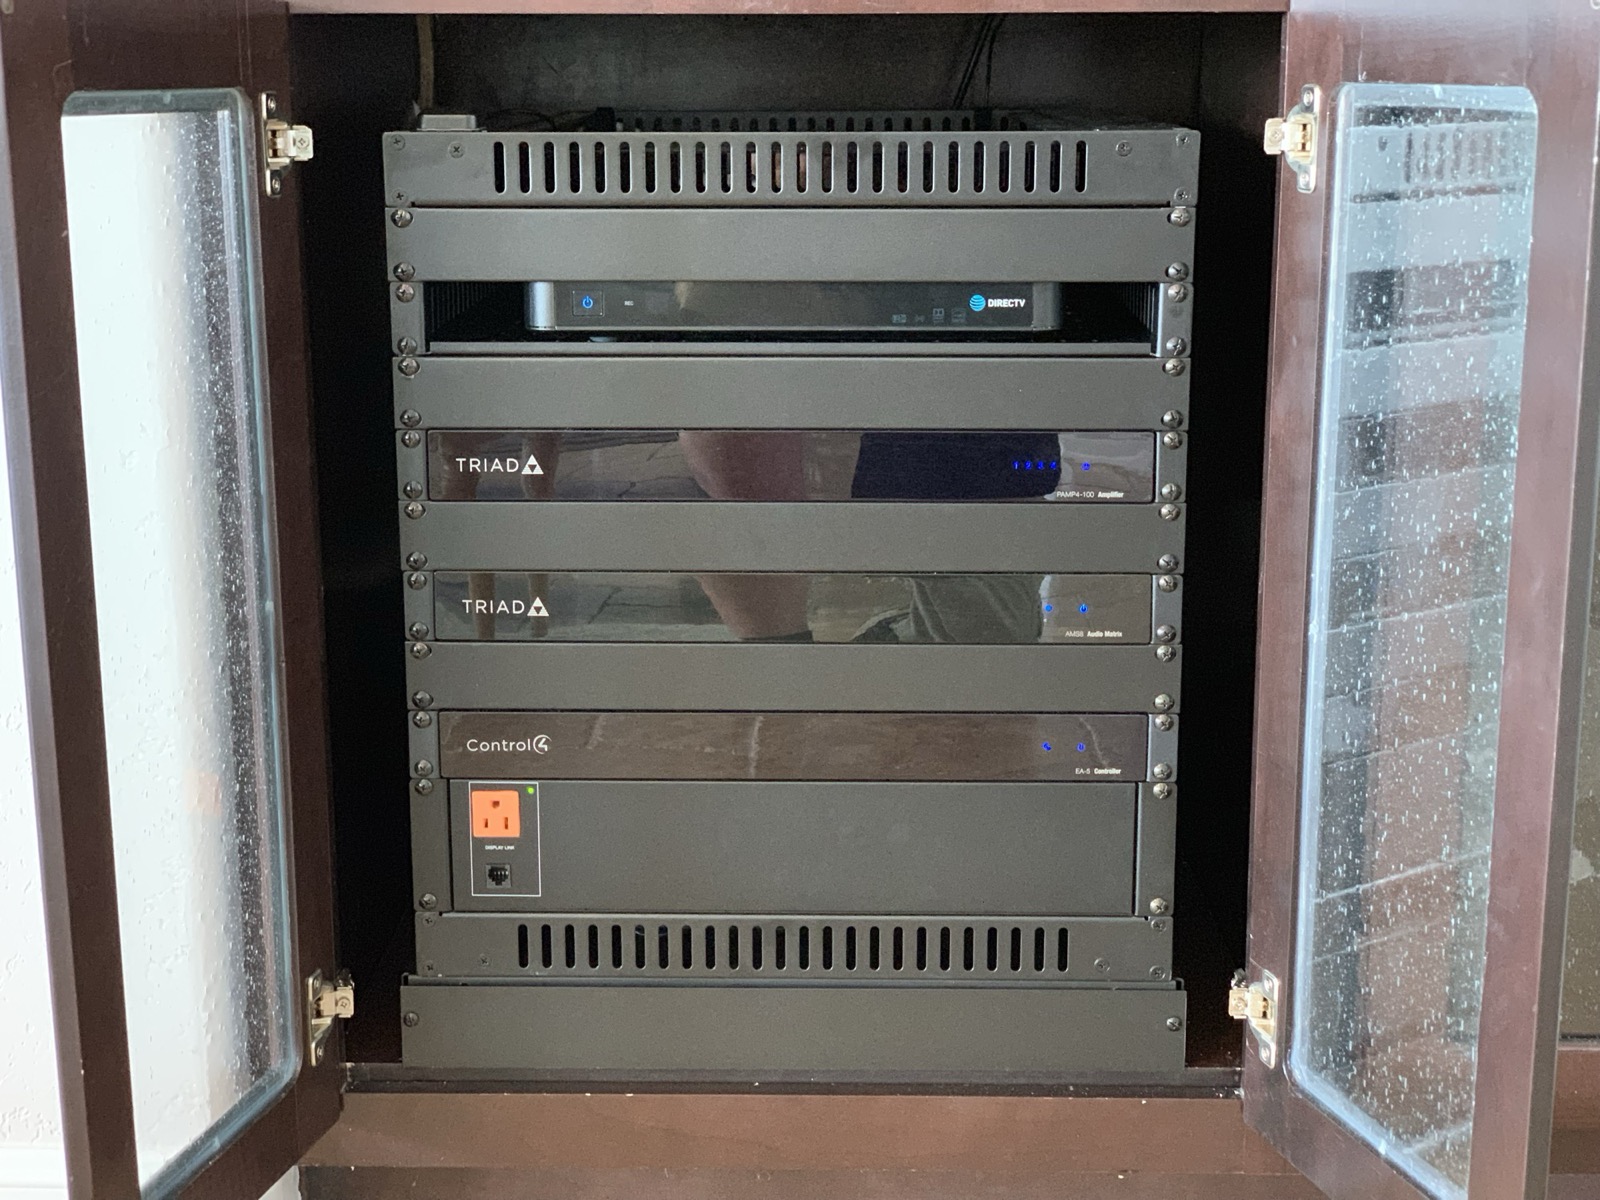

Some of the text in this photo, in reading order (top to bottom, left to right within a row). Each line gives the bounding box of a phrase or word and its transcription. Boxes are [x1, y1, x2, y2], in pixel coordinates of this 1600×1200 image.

[987, 298, 1026, 308] DIRECTV
[455, 457, 520, 473] TRIAD
[1013, 460, 1019, 470] 1
[1025, 460, 1032, 470] 2
[1037, 460, 1044, 470] 3
[1056, 490, 1125, 499] PAMP4-100 Amplifier
[461, 599, 526, 615] TRIAD
[1087, 630, 1104, 638] Audio
[1104, 630, 1123, 638] Matrix
[1075, 767, 1122, 775] EA-5 Controller
